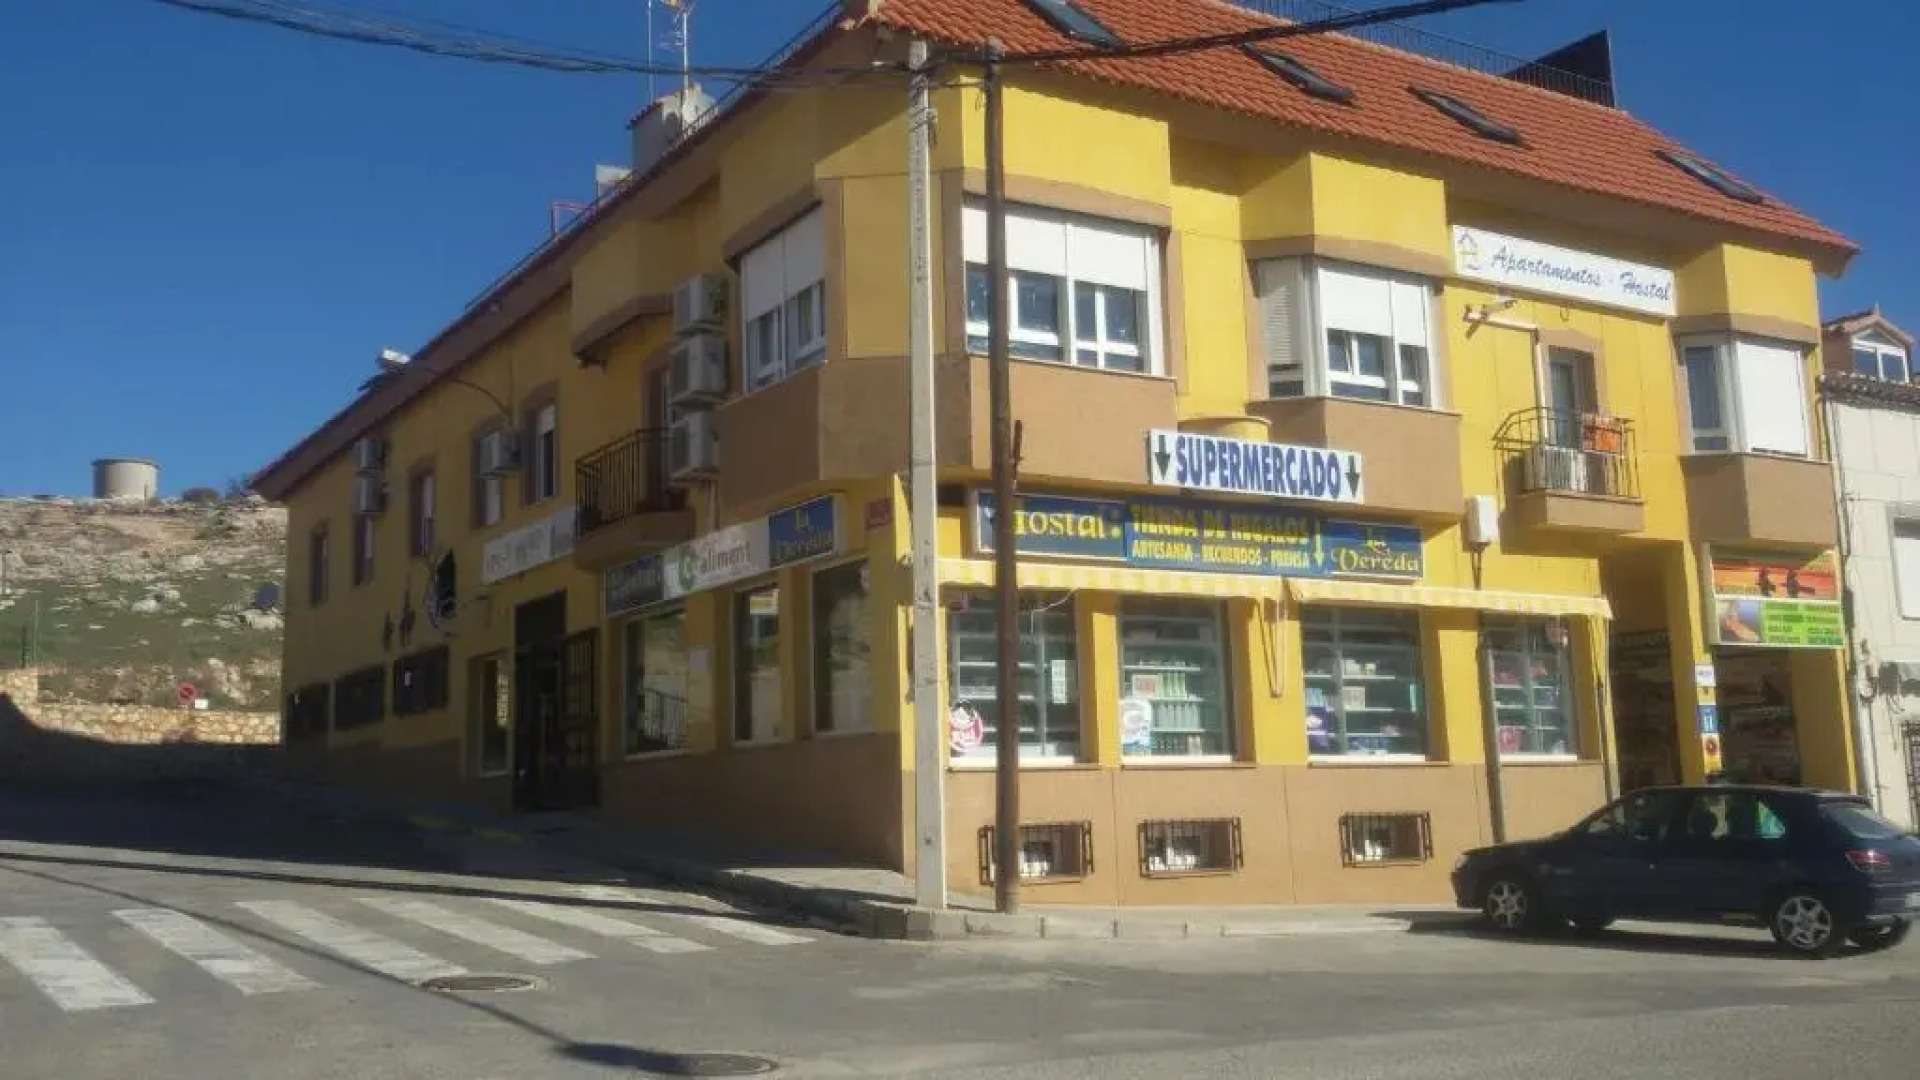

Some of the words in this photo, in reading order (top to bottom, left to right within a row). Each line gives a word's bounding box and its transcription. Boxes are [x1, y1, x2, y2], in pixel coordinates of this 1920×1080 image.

[1175, 434, 1342, 500] SUPERMERCADO
[1130, 503, 1198, 538] TIENDA
[1203, 509, 1227, 539] DE
[1230, 513, 1310, 545] REGALOS
